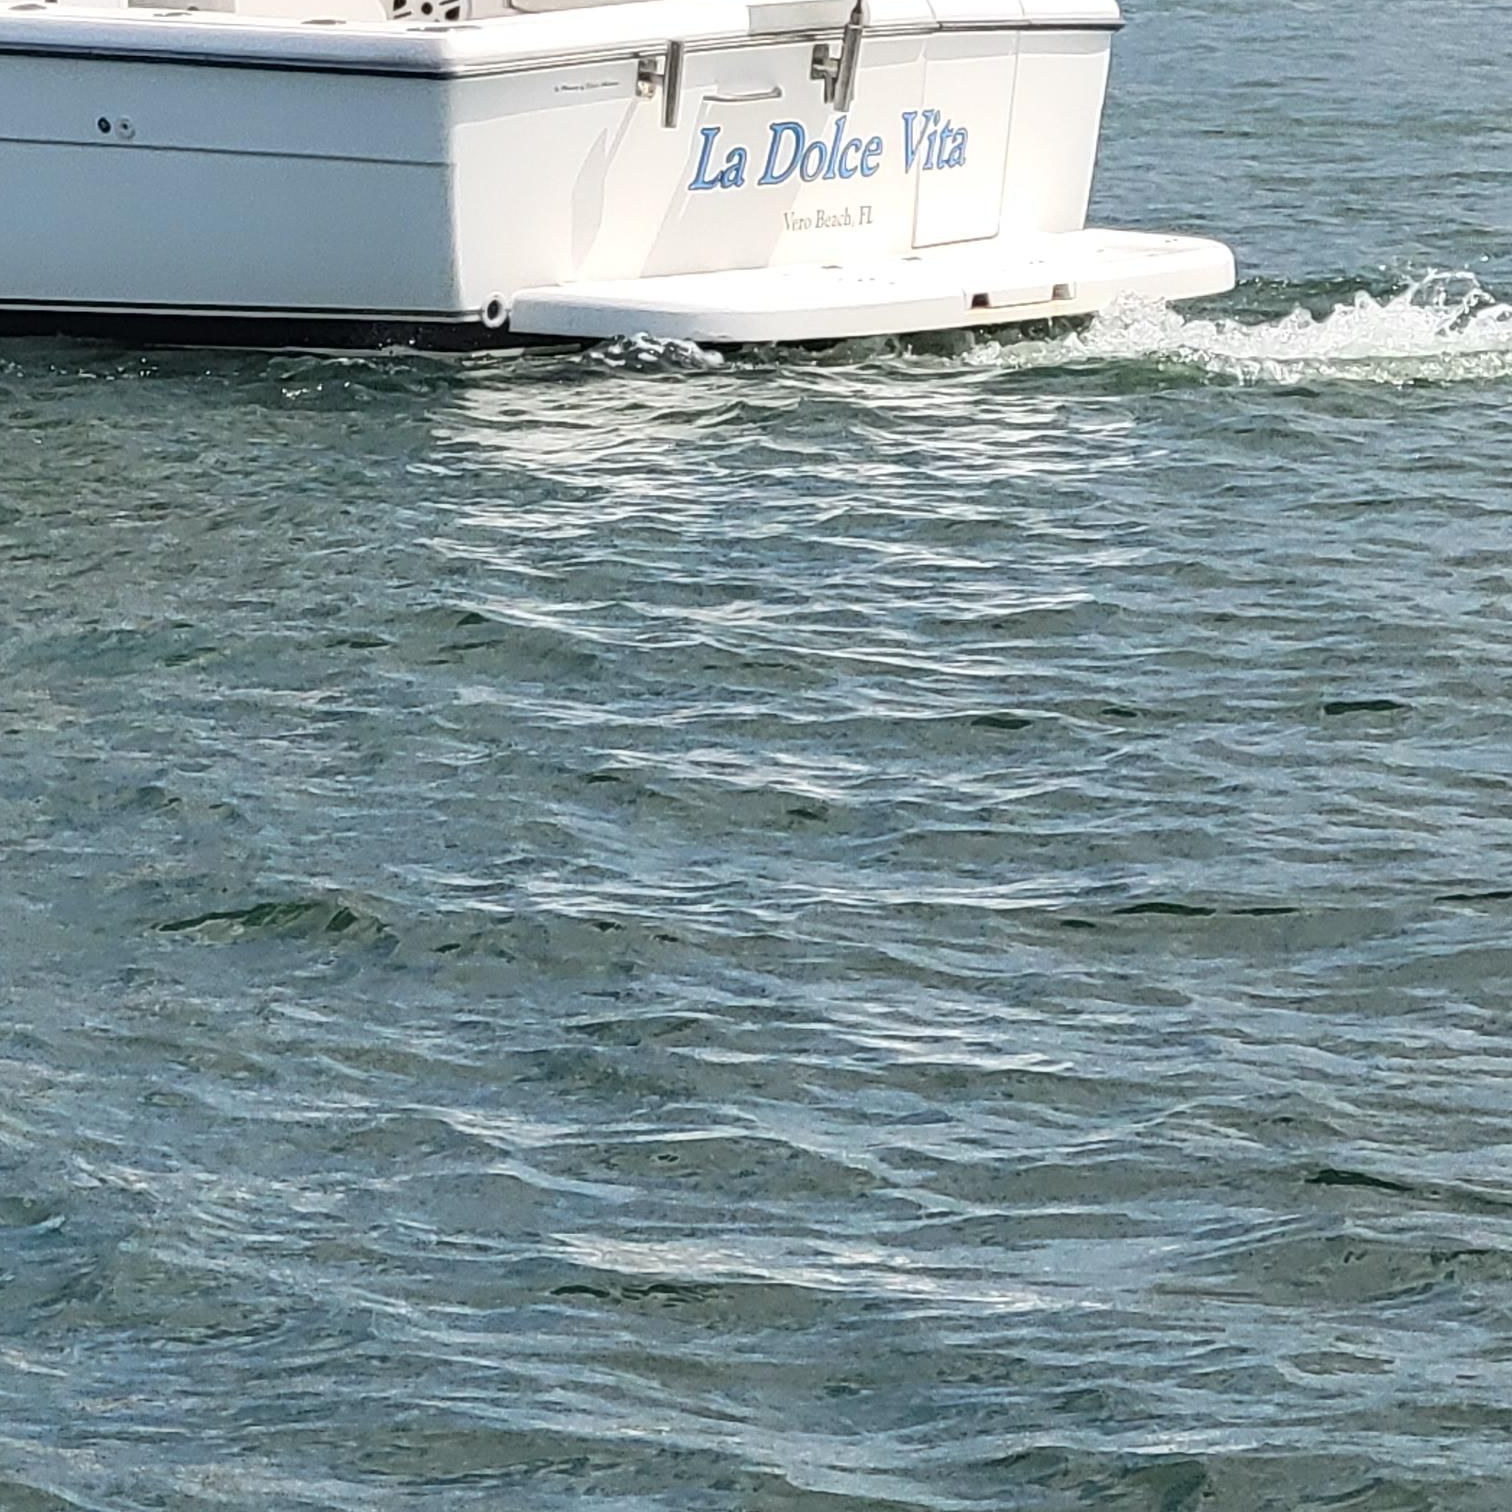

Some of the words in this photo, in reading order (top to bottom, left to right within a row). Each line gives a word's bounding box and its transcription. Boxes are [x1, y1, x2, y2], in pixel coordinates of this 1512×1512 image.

[688, 127, 748, 191] La
[758, 115, 883, 185] Dolce
[901, 109, 969, 173] Vita
[783, 212, 812, 231] Vero
[858, 205, 873, 225] FL
